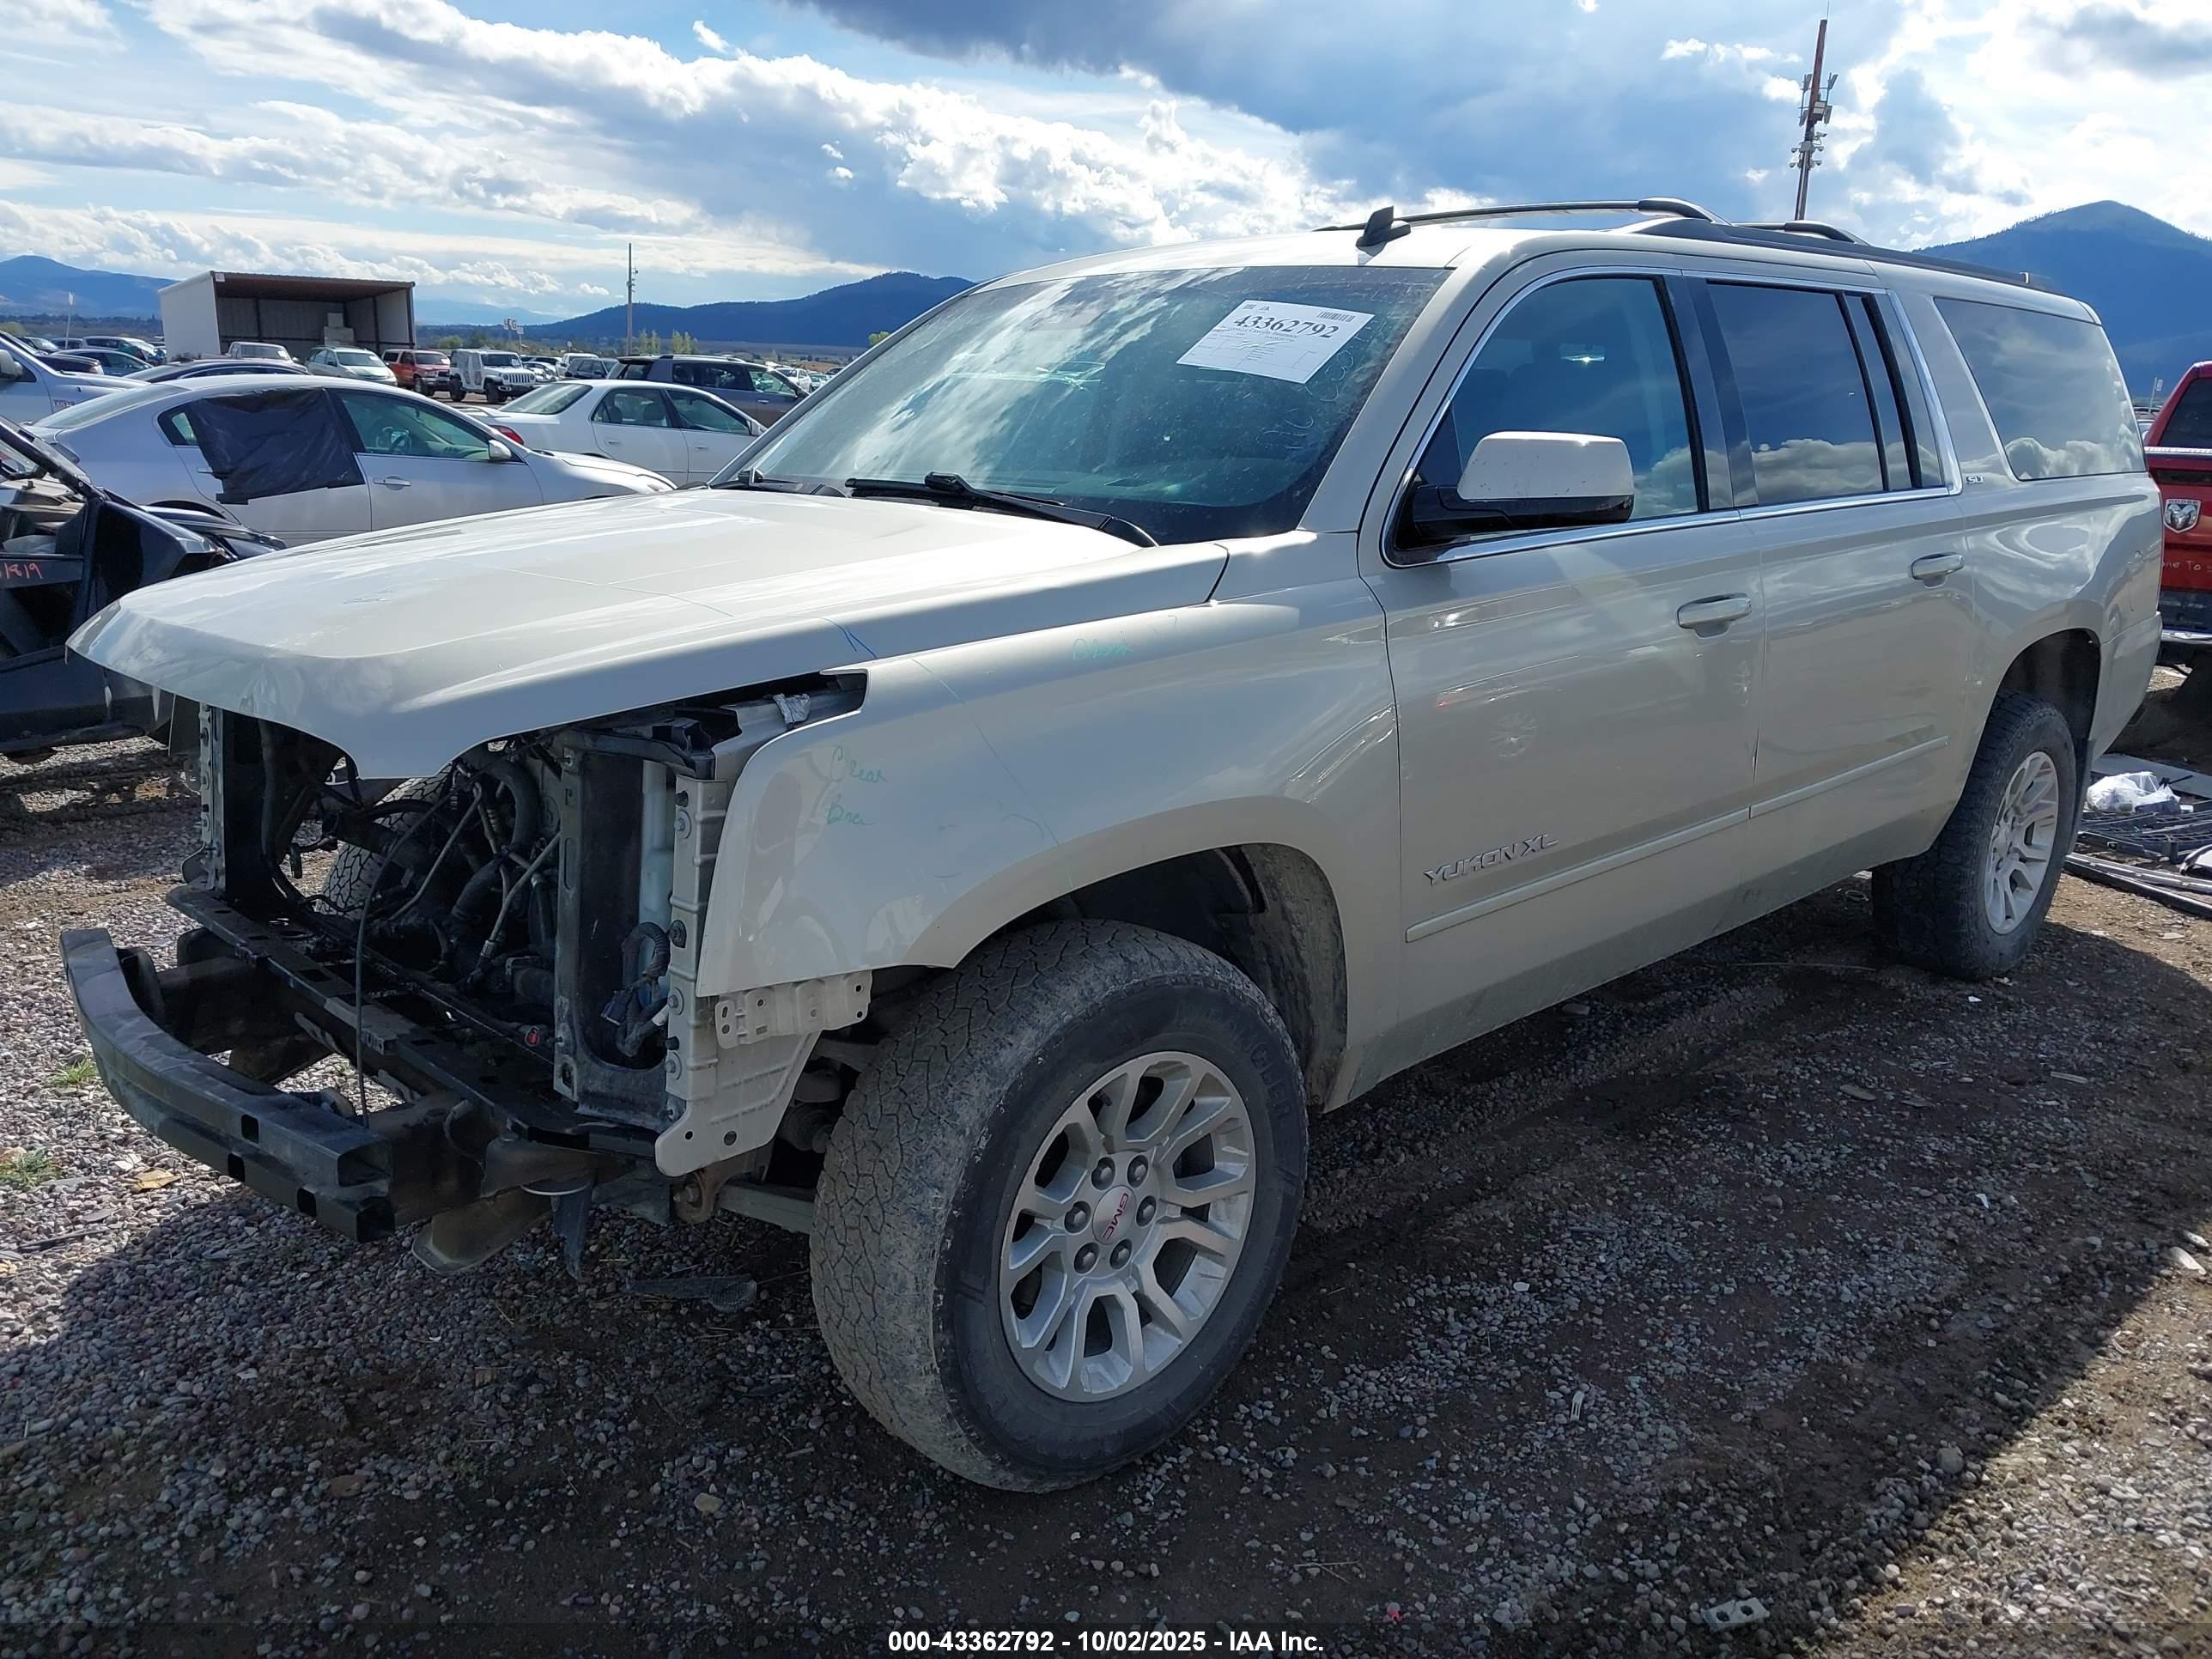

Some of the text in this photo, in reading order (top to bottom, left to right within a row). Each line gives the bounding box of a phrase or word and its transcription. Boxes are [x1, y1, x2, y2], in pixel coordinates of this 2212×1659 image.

[1233, 314, 1340, 338] 43362792
[1966, 475, 1985, 484] SLT
[0, 562, 43, 579] 1819
[1423, 832, 1559, 886] YUKON XL
[1103, 1193, 1129, 1241] GMC
